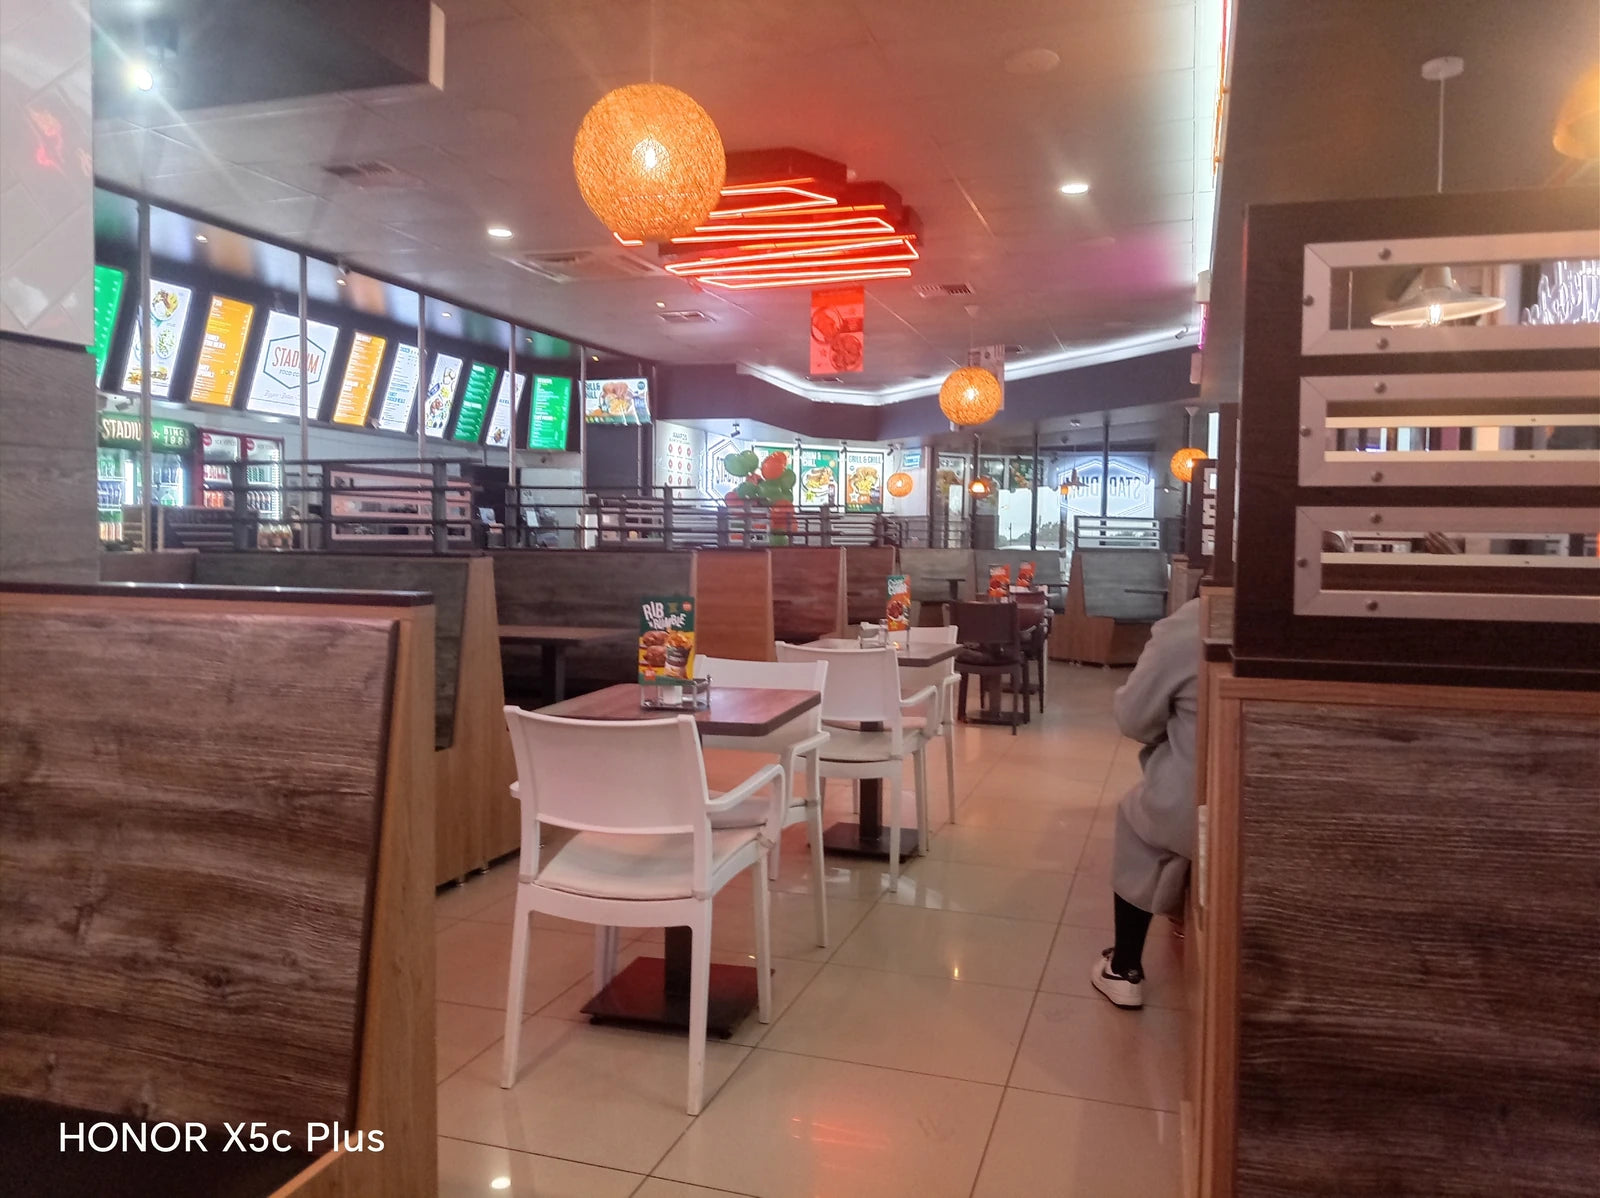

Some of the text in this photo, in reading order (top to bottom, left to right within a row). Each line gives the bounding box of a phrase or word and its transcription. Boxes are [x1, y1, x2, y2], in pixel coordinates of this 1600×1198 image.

[272, 346, 320, 375] STADM
[101, 419, 144, 441] STADIU
[642, 601, 665, 621] RIB
